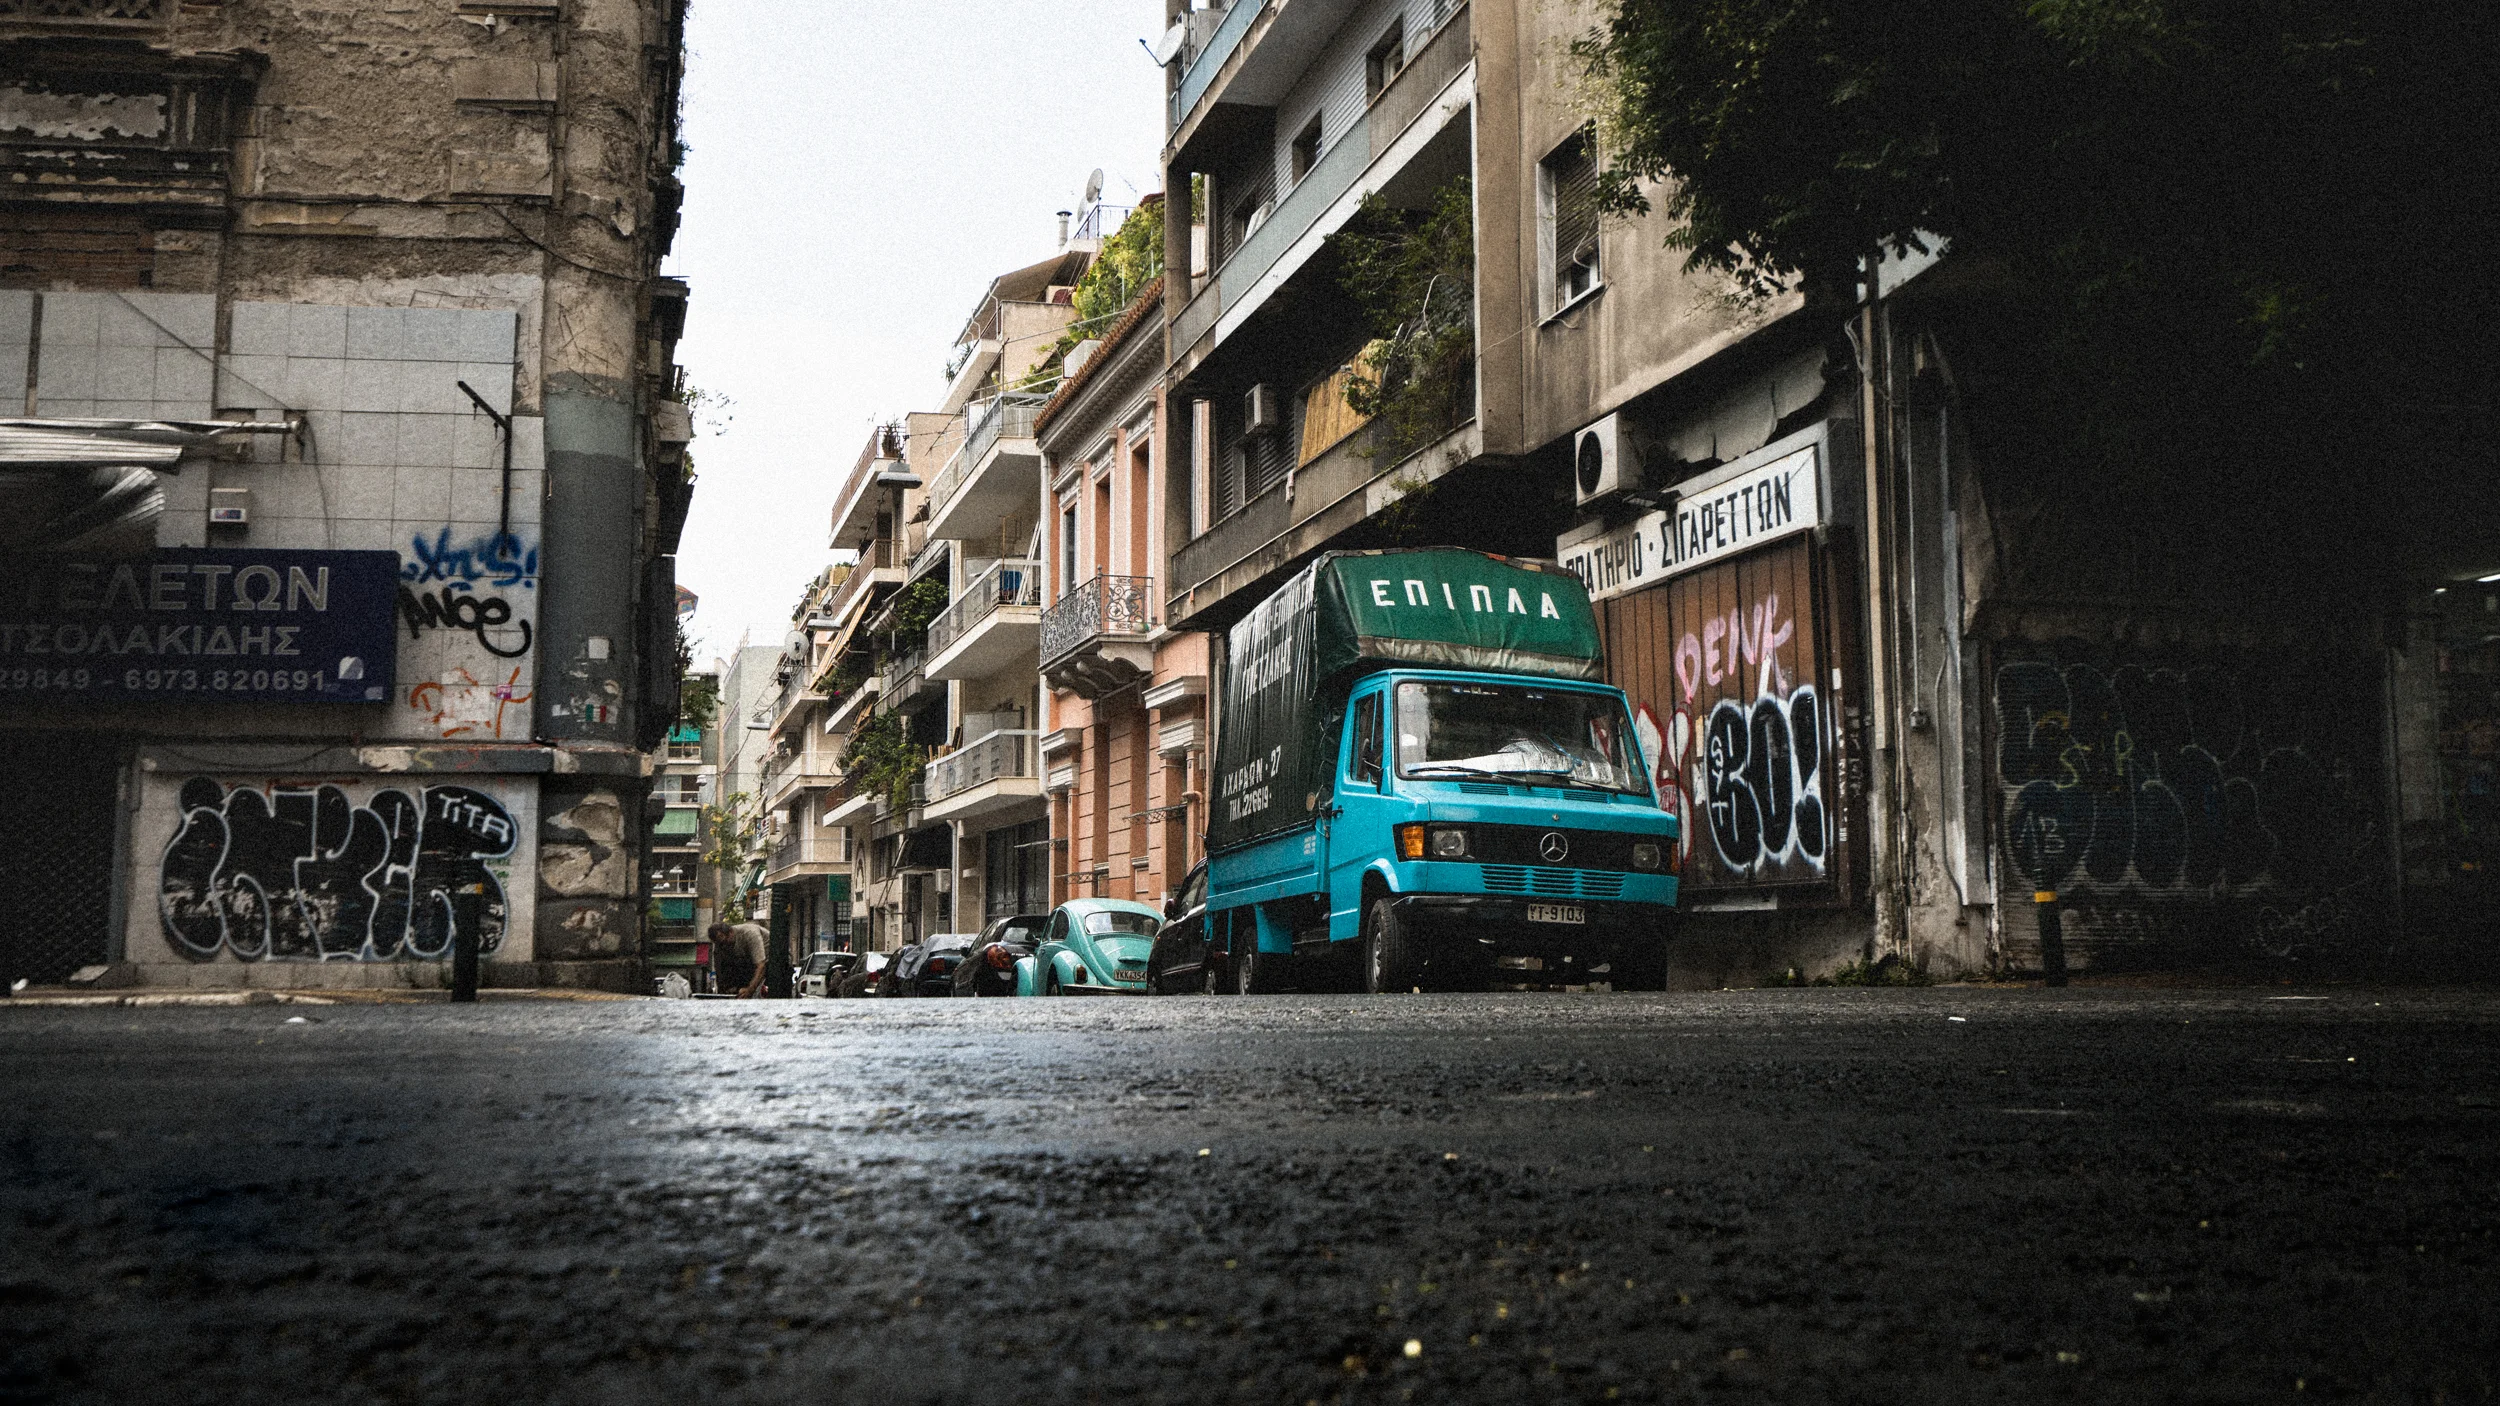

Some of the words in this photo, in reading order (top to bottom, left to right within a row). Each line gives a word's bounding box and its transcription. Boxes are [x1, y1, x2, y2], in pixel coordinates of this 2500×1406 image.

[1566, 531, 1643, 594] ΡΑΤΗΡΙΟ
[1660, 471, 1792, 569] ΣΙΓΑΡΕΤΤΩΝ
[27, 563, 330, 612] ΕΛΕΤΩΝ
[1370, 580, 1561, 620] ΕΠΙΠΛΑ
[124, 669, 325, 691] 6973.820691
[1271, 745, 1281, 778] 27
